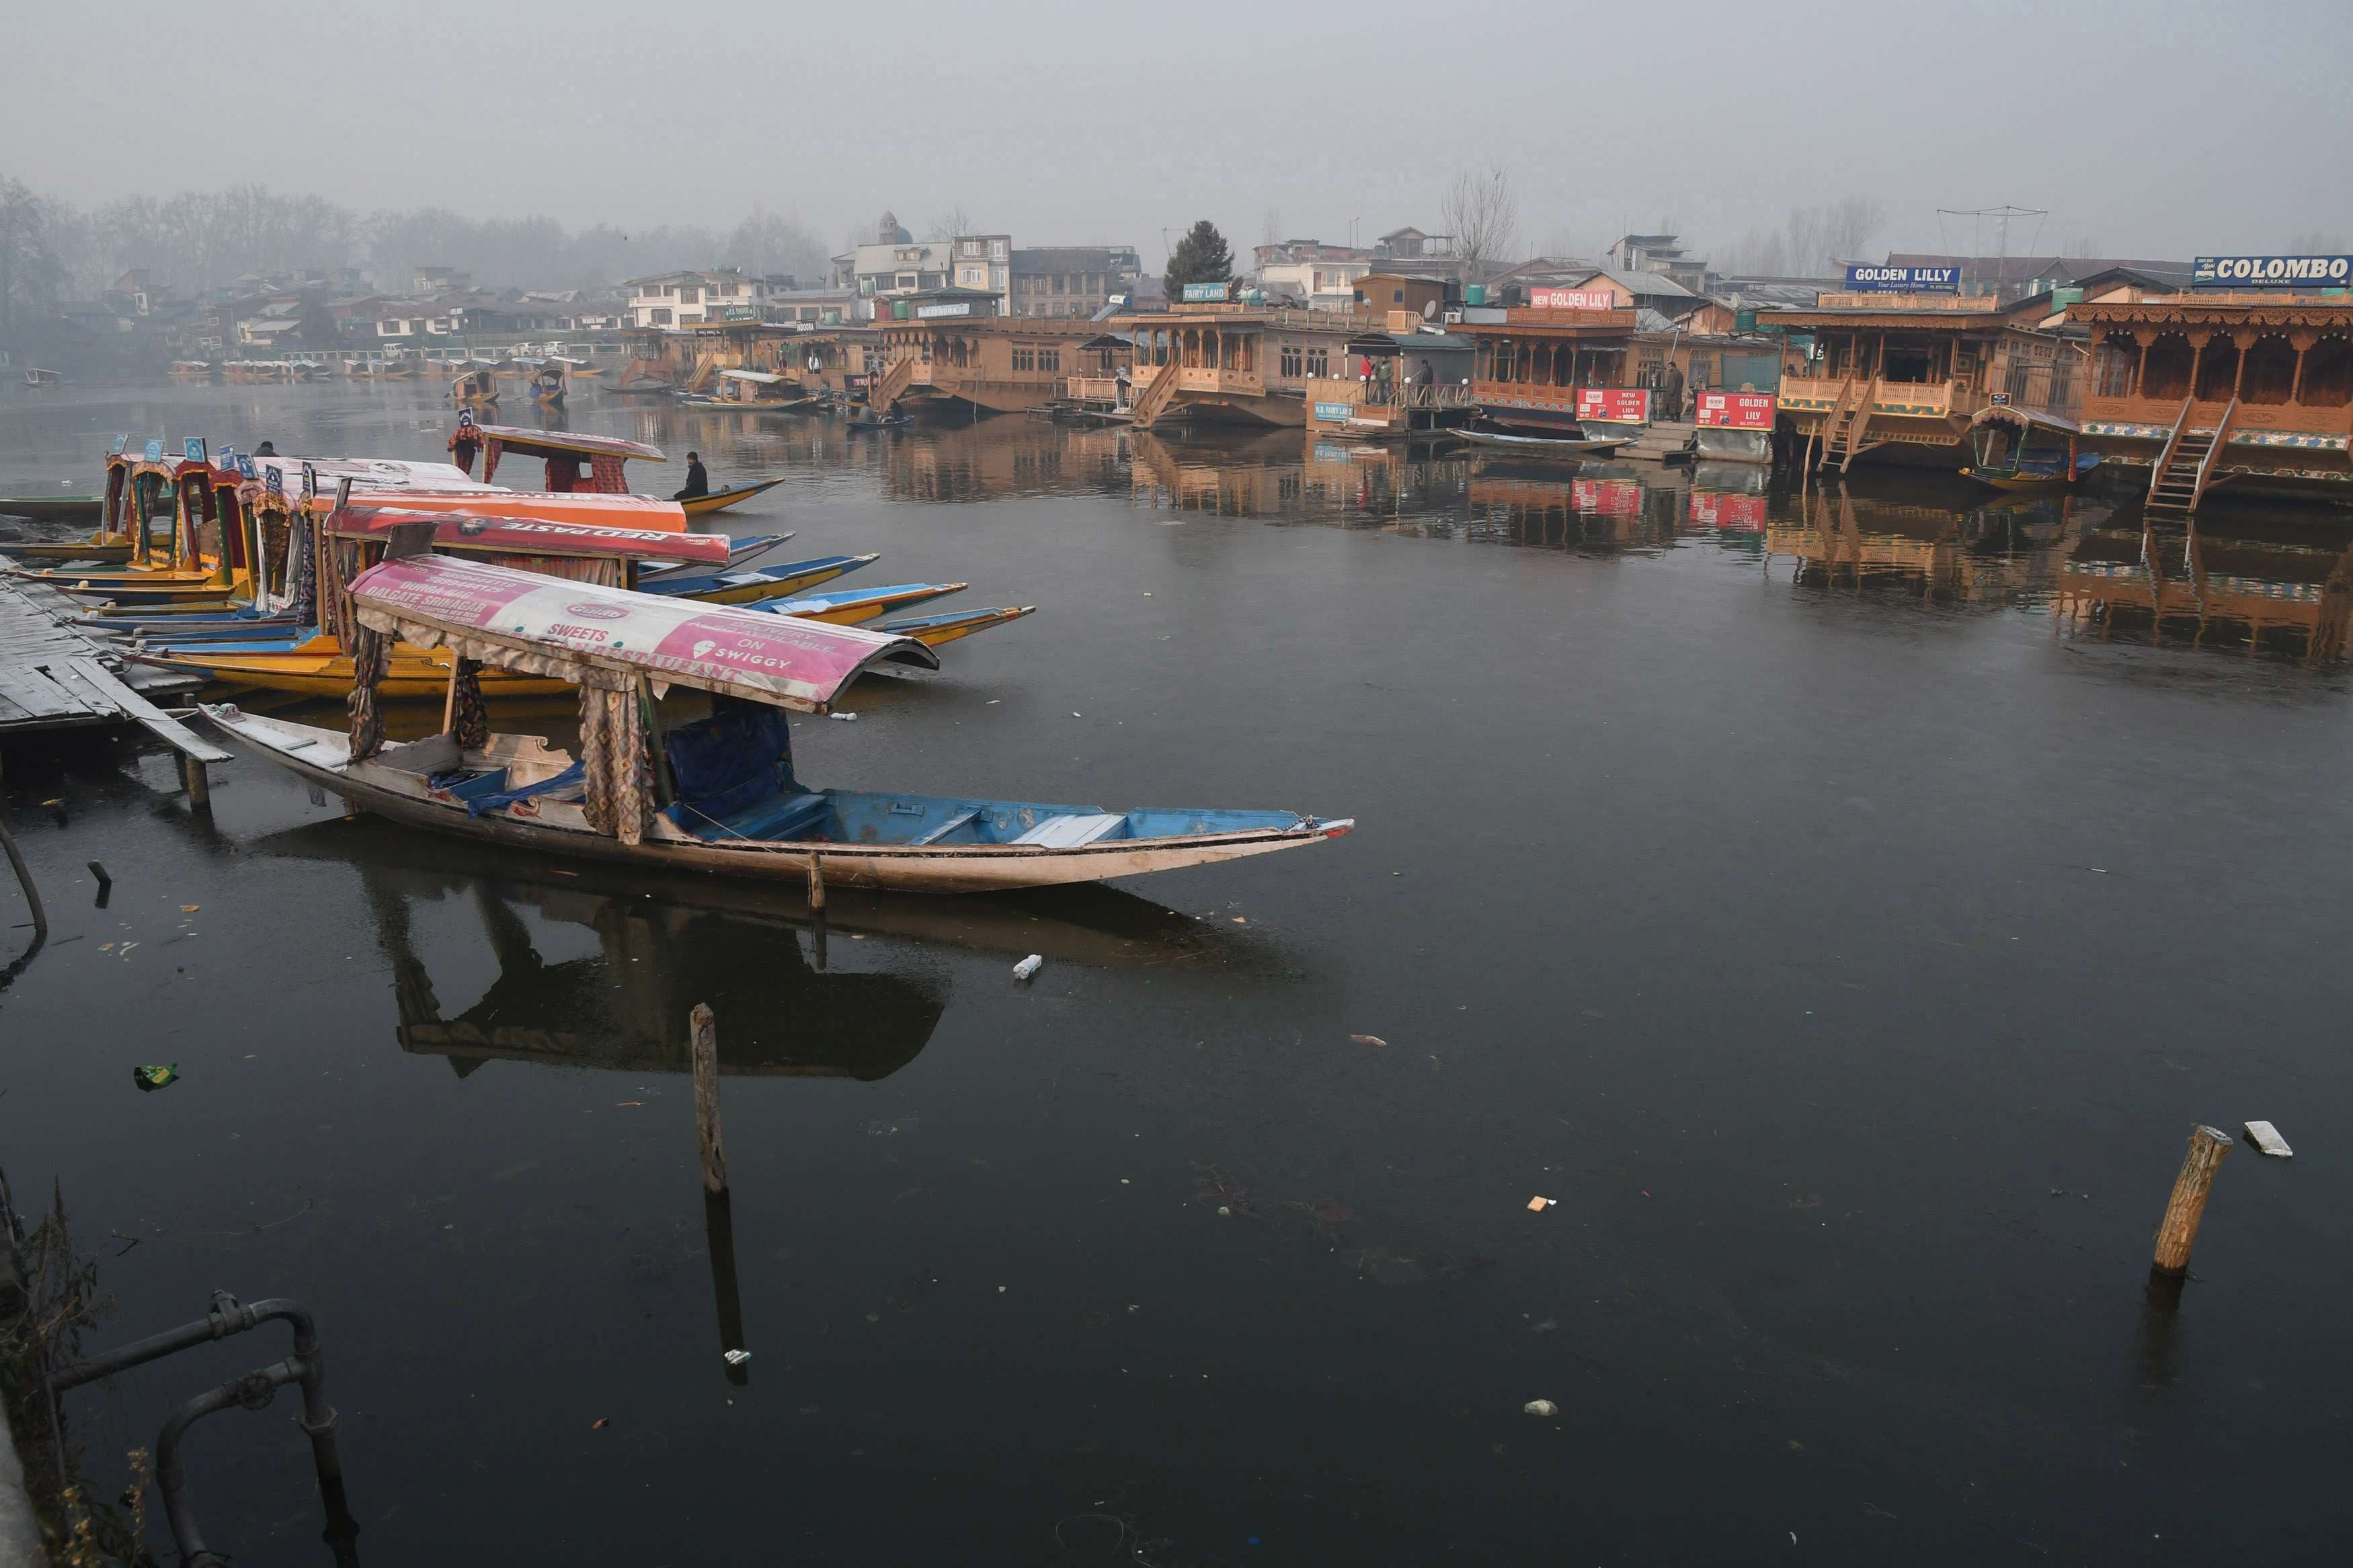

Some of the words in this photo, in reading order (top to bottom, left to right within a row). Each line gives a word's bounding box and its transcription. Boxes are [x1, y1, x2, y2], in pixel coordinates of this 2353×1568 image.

[1856, 268, 1907, 281] GOLDEN
[1915, 269, 1952, 282] LILLY
[2217, 258, 2348, 278] COLOMBO
[1185, 289, 1203, 299] FAIRY
[1205, 288, 1224, 298] LAND
[1533, 295, 1548, 305] NEW
[1550, 292, 1587, 306] GOLDEN
[1589, 294, 1609, 307] LILY
[1739, 398, 1769, 407] GOLDEN
[1326, 406, 1339, 415] FAIRY
[1745, 411, 1761, 420] LILY
[500, 522, 592, 536] PASTE
[593, 529, 668, 542] RED
[366, 586, 424, 603] DALGATE
[420, 595, 487, 612] SRINAGAR
[570, 606, 621, 618] Gulab
[547, 623, 610, 642] SWEETS
[688, 622, 737, 633] ALSO
[738, 630, 838, 653] AVAILABLE
[731, 622, 819, 640] DELIVERY
[737, 638, 766, 650] ON
[592, 644, 743, 682] RESTAURANT
[715, 648, 791, 669] SWIGGY
